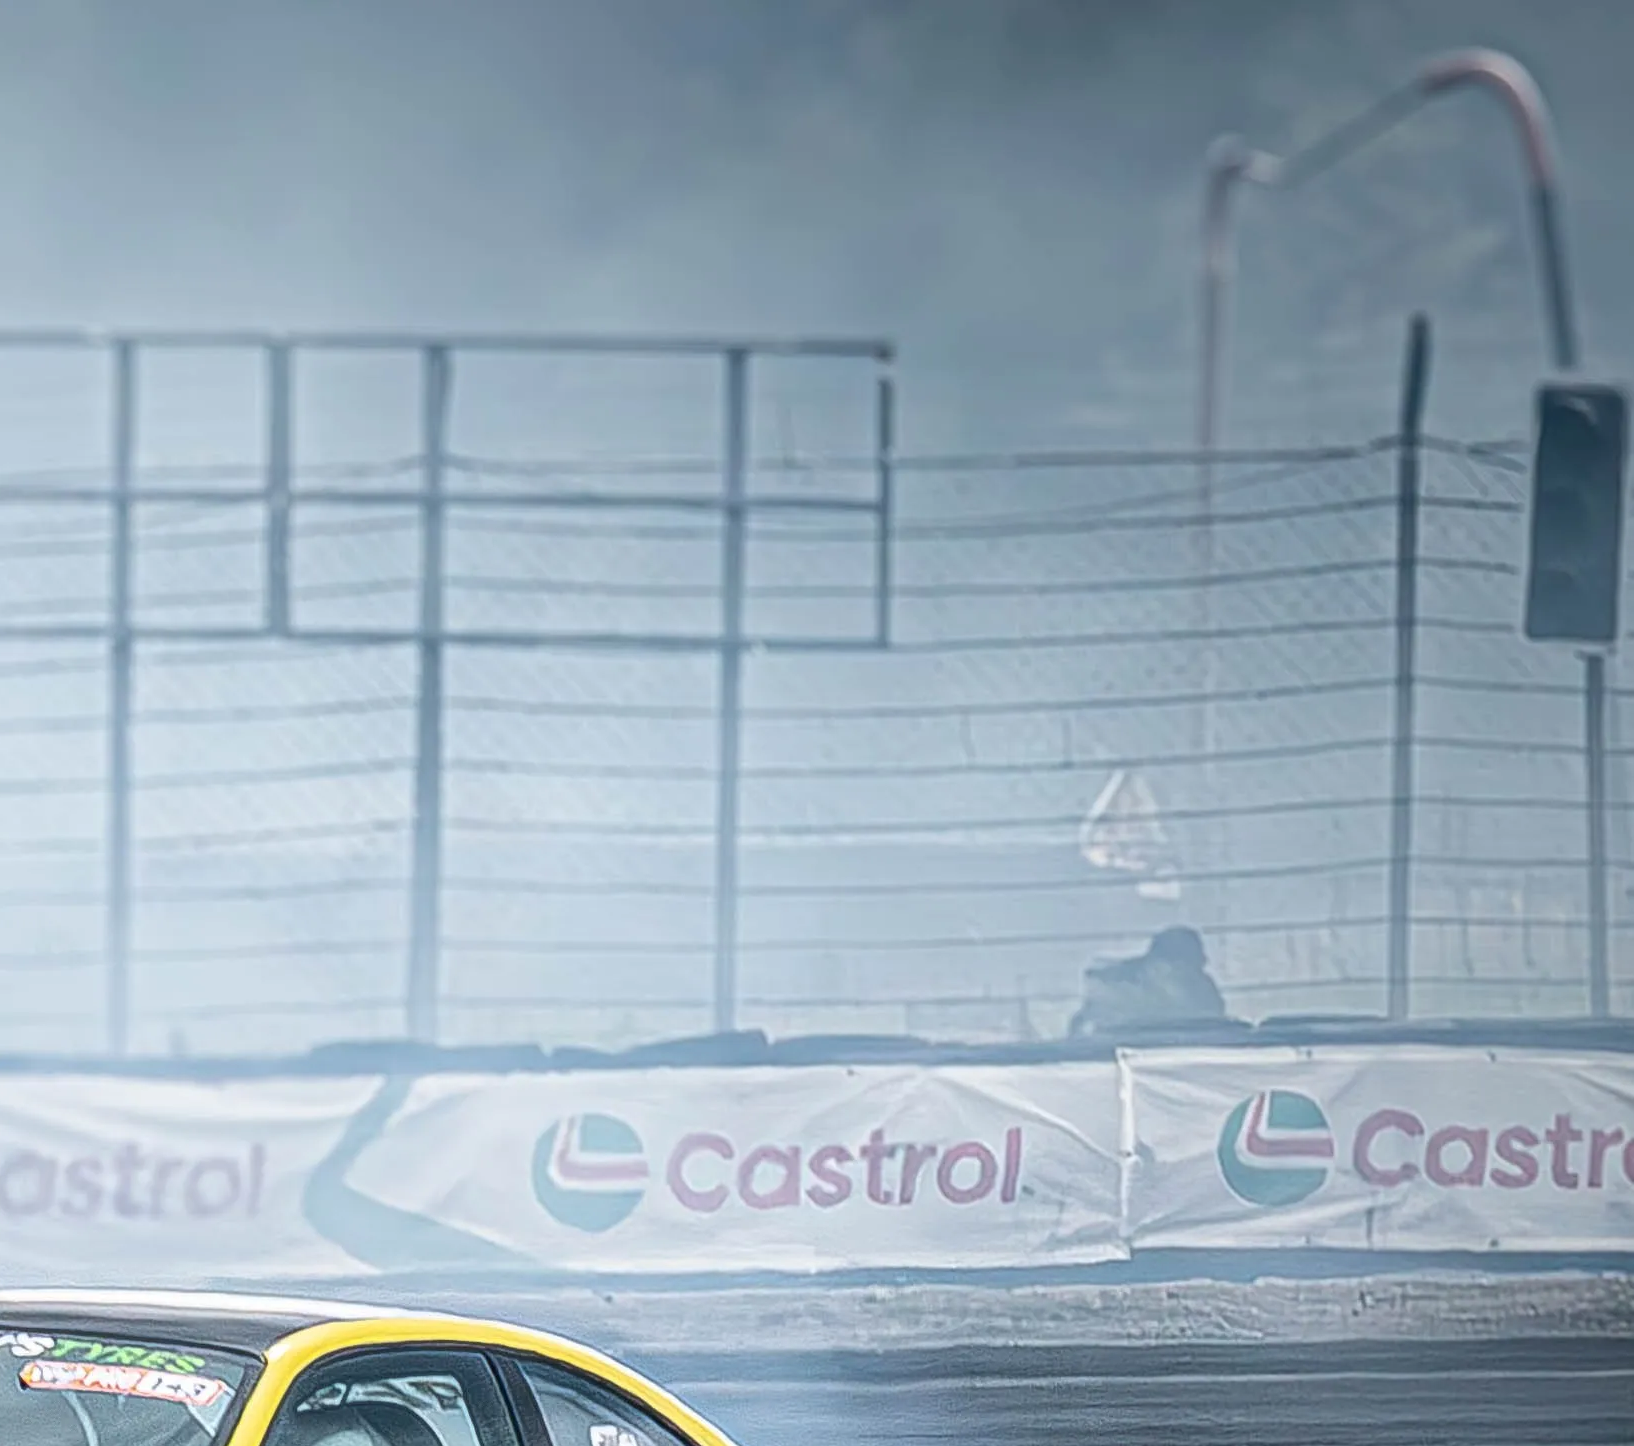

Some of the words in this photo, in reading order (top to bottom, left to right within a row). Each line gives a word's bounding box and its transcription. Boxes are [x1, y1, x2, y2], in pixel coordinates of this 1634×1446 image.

[666, 1127, 1022, 1212] Castrol
[1353, 1108, 1634, 1190] Castr
[52, 1338, 206, 1373] TYRES
